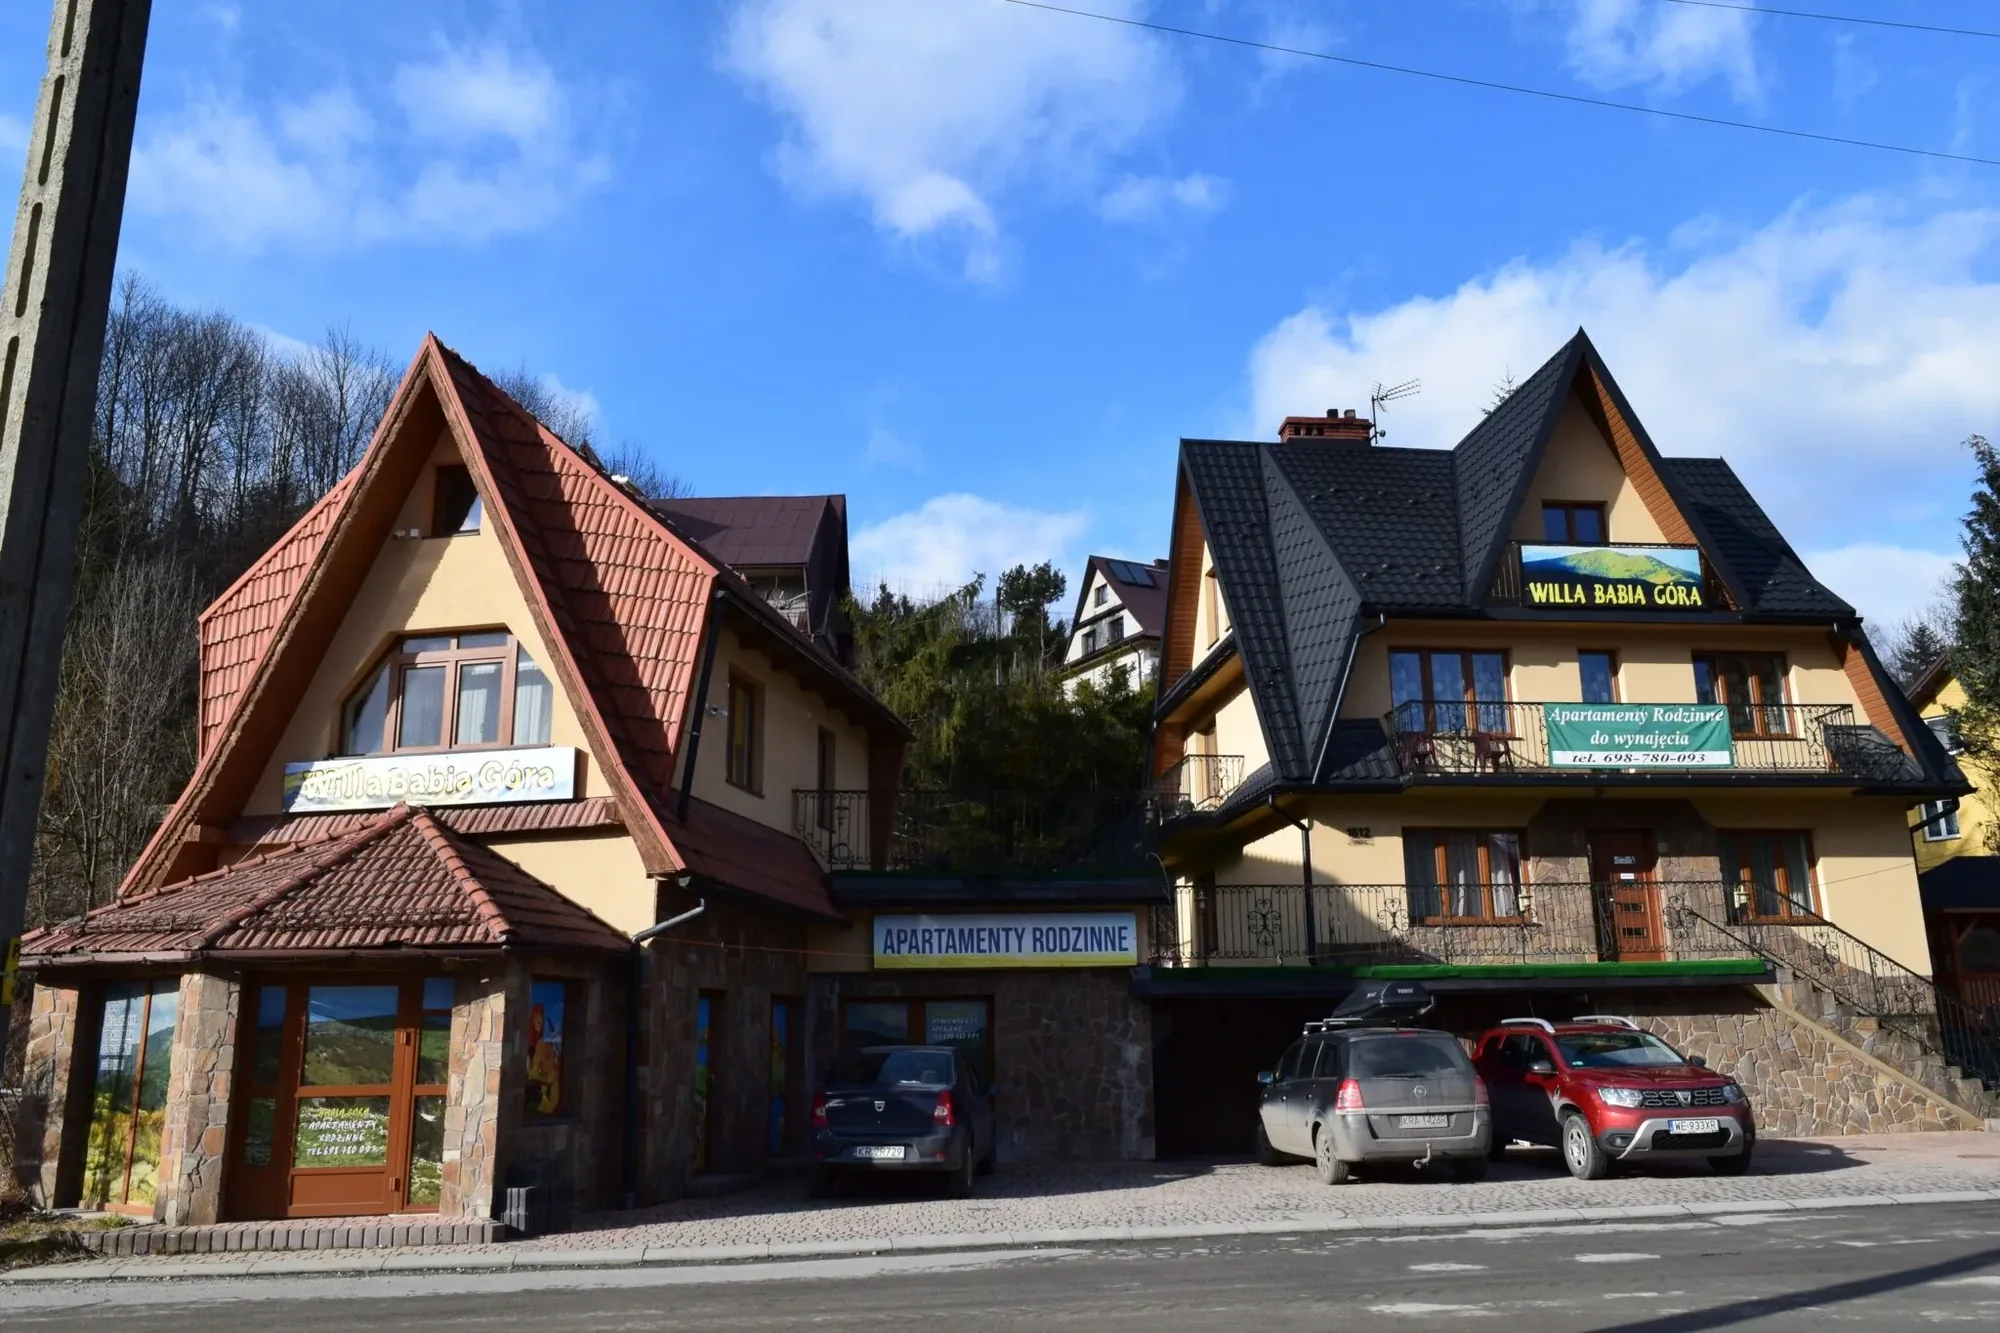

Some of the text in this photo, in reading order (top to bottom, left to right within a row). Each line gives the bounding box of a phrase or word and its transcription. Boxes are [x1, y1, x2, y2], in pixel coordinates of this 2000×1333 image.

[1529, 582, 1702, 606] WILLA BABIA GÓRA
[1549, 707, 1724, 725] Apartamenty Rodzinne
[1590, 730, 1689, 748] do wynajęcia
[1572, 753, 1706, 763] tel. 698-780-093
[303, 759, 556, 799] Willa Babia Góra
[883, 926, 1129, 954] APARTAMENTY RODZINNE
[1689, 1120, 1716, 1130] 933XR
